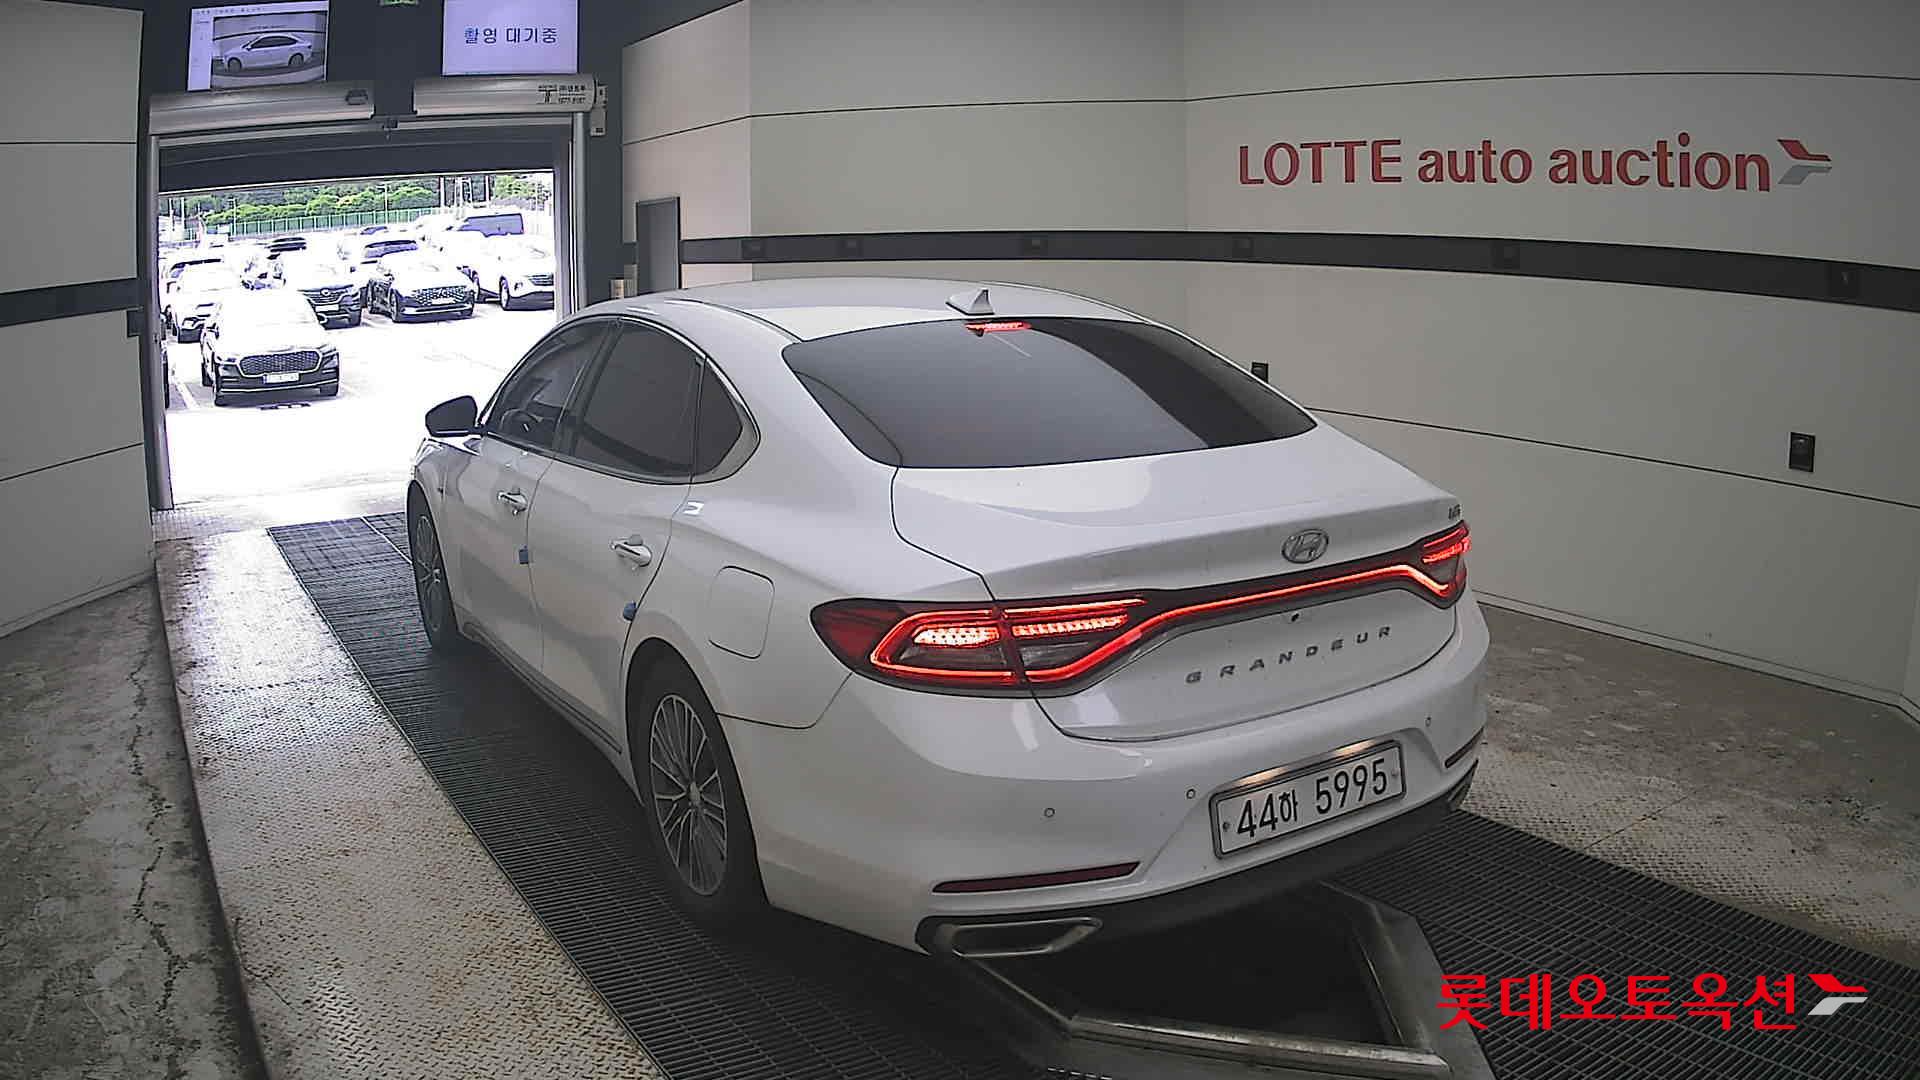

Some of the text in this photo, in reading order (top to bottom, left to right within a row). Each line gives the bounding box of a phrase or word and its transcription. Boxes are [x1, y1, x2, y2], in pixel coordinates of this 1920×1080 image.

[506, 27, 558, 45] 대기중
[1239, 131, 1771, 193] LOTTE auto auction
[1185, 625, 1391, 685] GRANDEUR
[1236, 757, 1388, 838] 44하 5995
